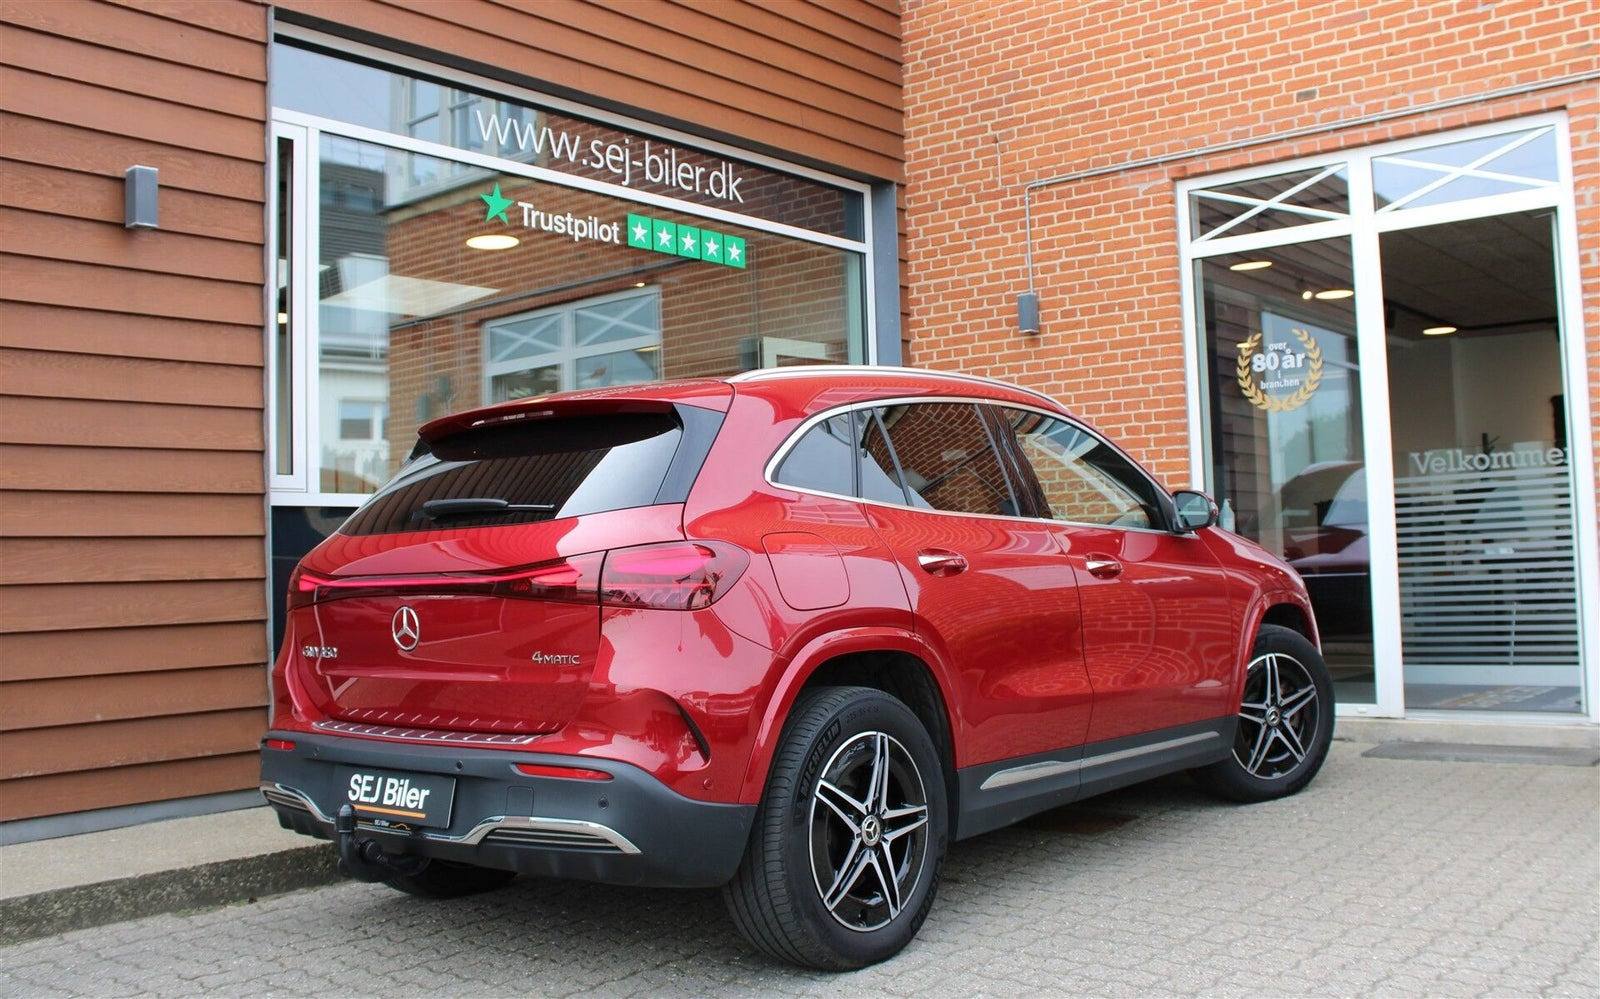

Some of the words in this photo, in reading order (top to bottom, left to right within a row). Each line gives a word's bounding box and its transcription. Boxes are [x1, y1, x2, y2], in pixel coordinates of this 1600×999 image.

[475, 110, 744, 204] www.sej-biler.dk
[518, 201, 620, 245] Trustpilot
[1252, 353, 1280, 372] 80
[1282, 348, 1306, 369] år
[1269, 342, 1287, 351] over
[1261, 379, 1299, 389] branchen
[532, 651, 580, 664] 4MATIC
[800, 722, 839, 797] MICHELIN
[347, 773, 382, 803] SEJ
[383, 777, 430, 809] Biler
